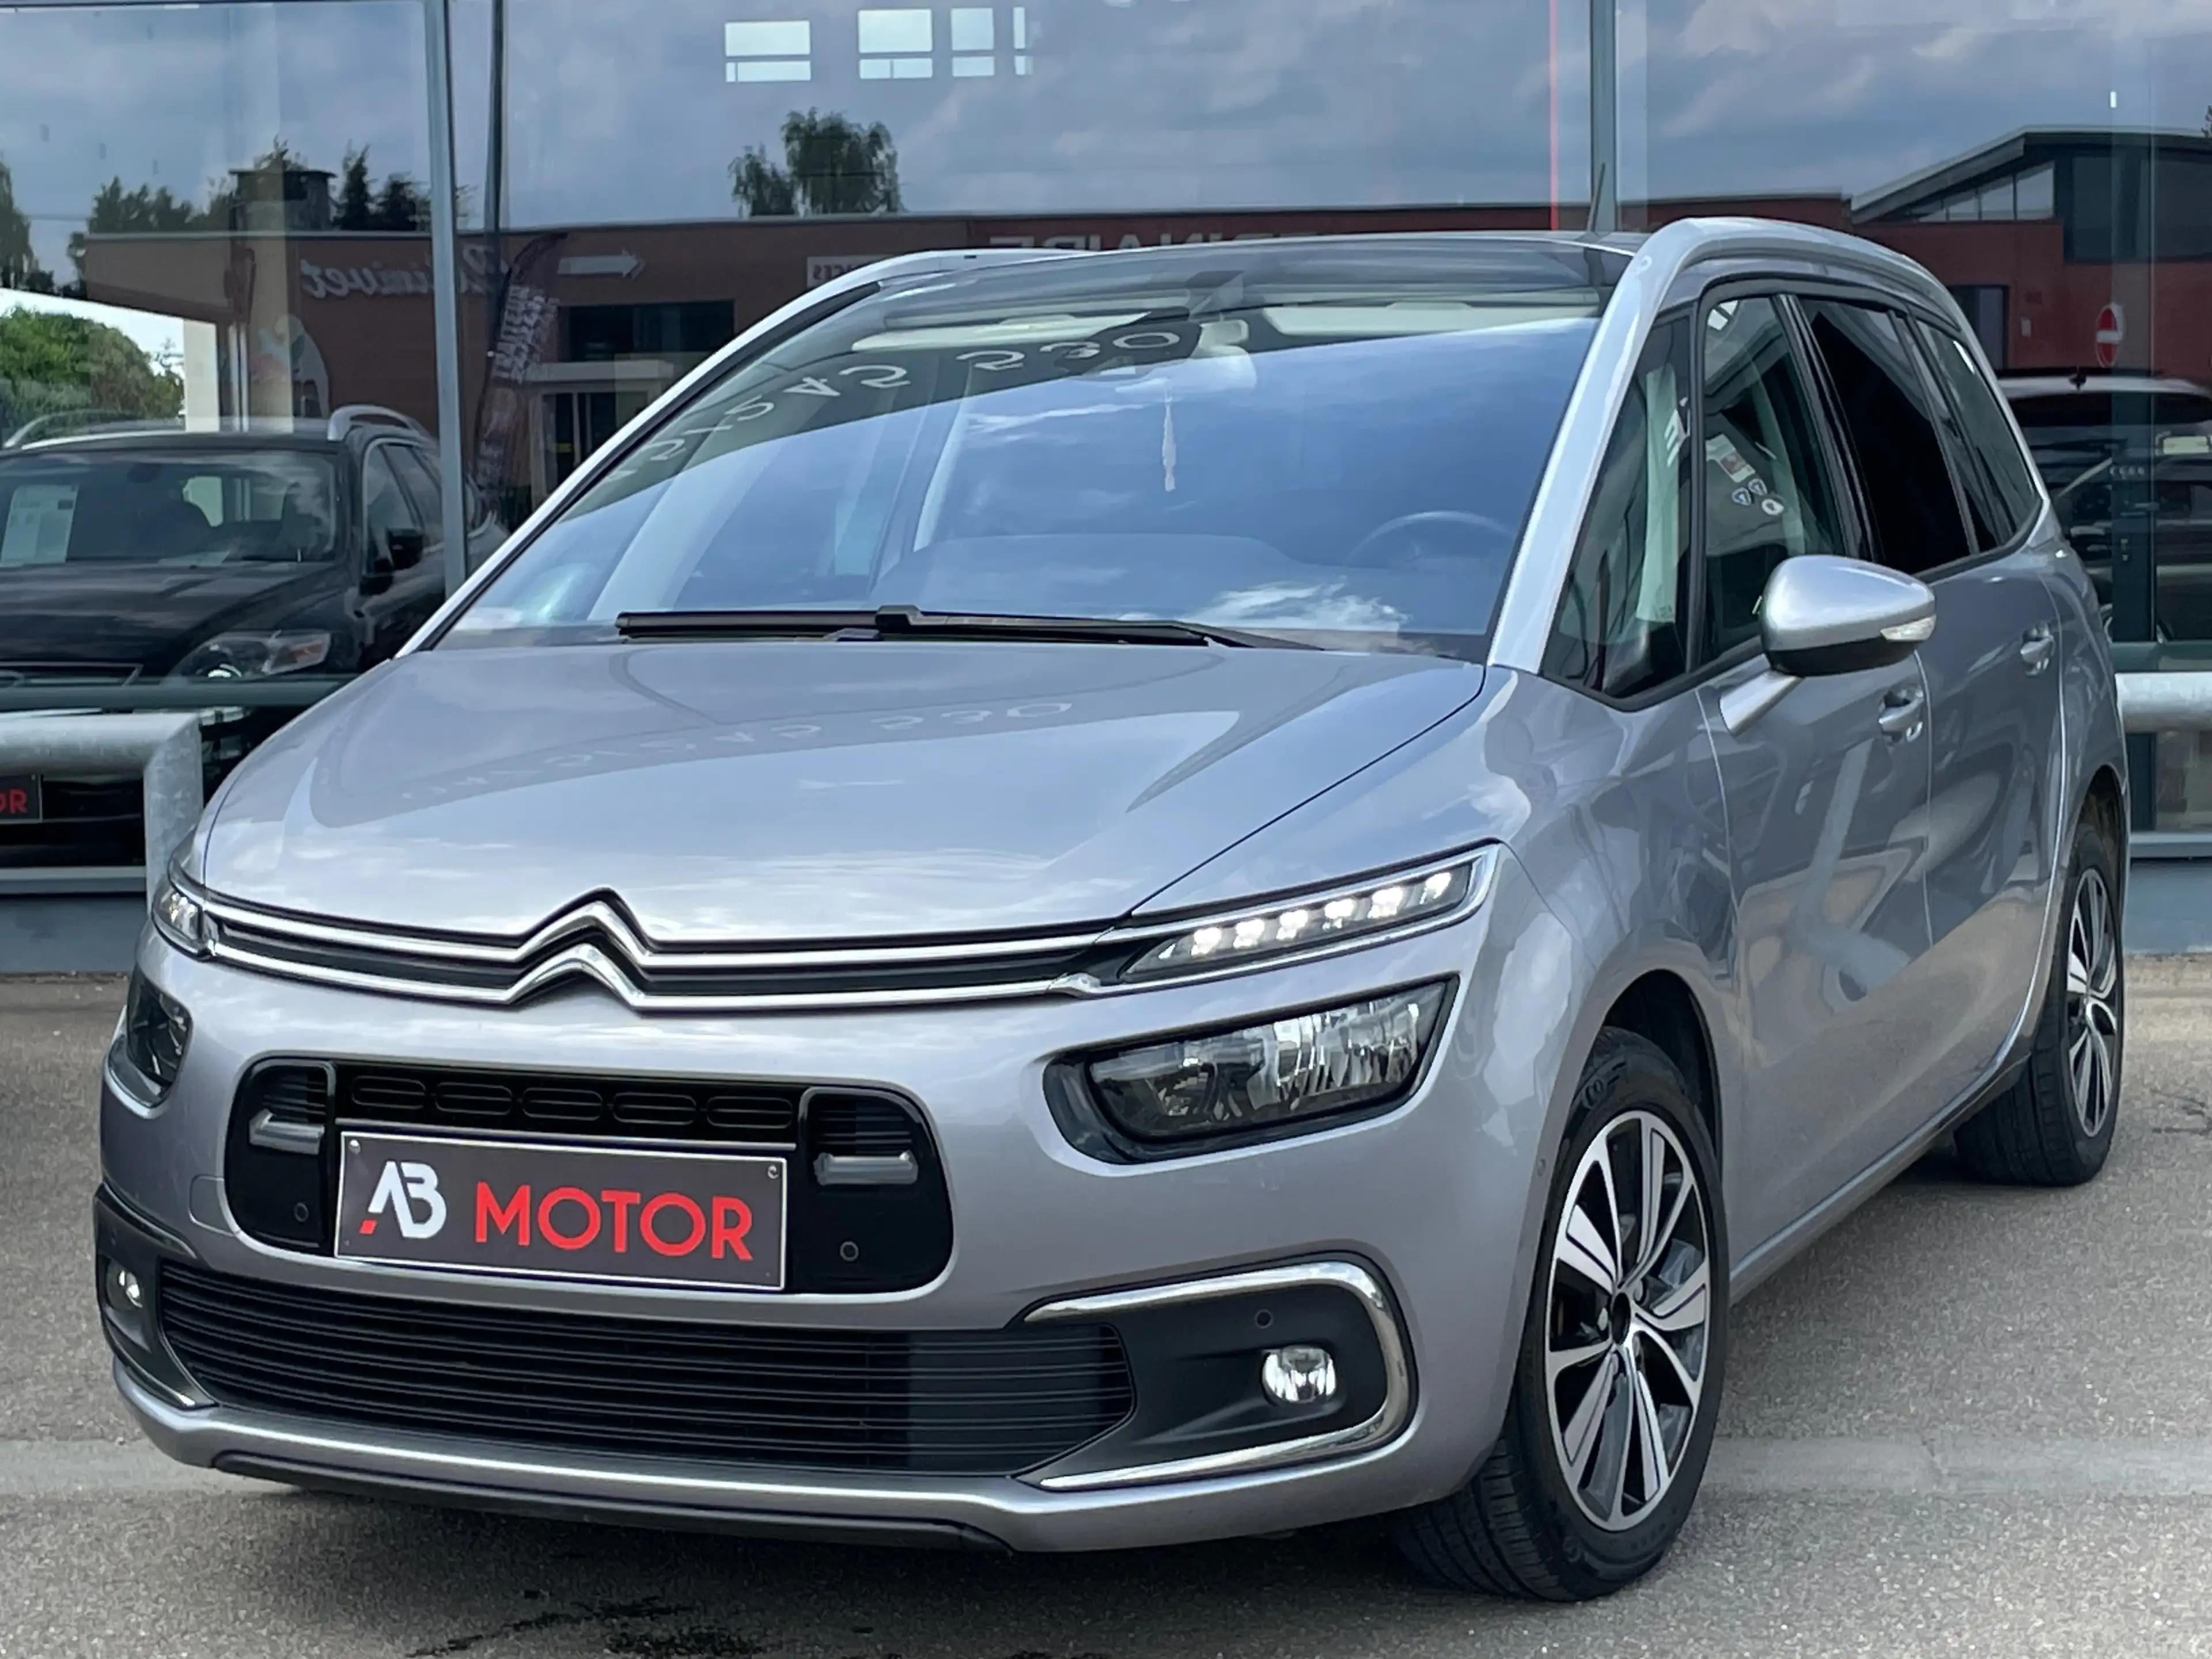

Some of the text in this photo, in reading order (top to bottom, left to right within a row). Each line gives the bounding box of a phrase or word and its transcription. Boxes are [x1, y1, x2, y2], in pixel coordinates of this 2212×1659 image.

[0, 789, 27, 814] R
[359, 1160, 753, 1262] AB MOTOR
